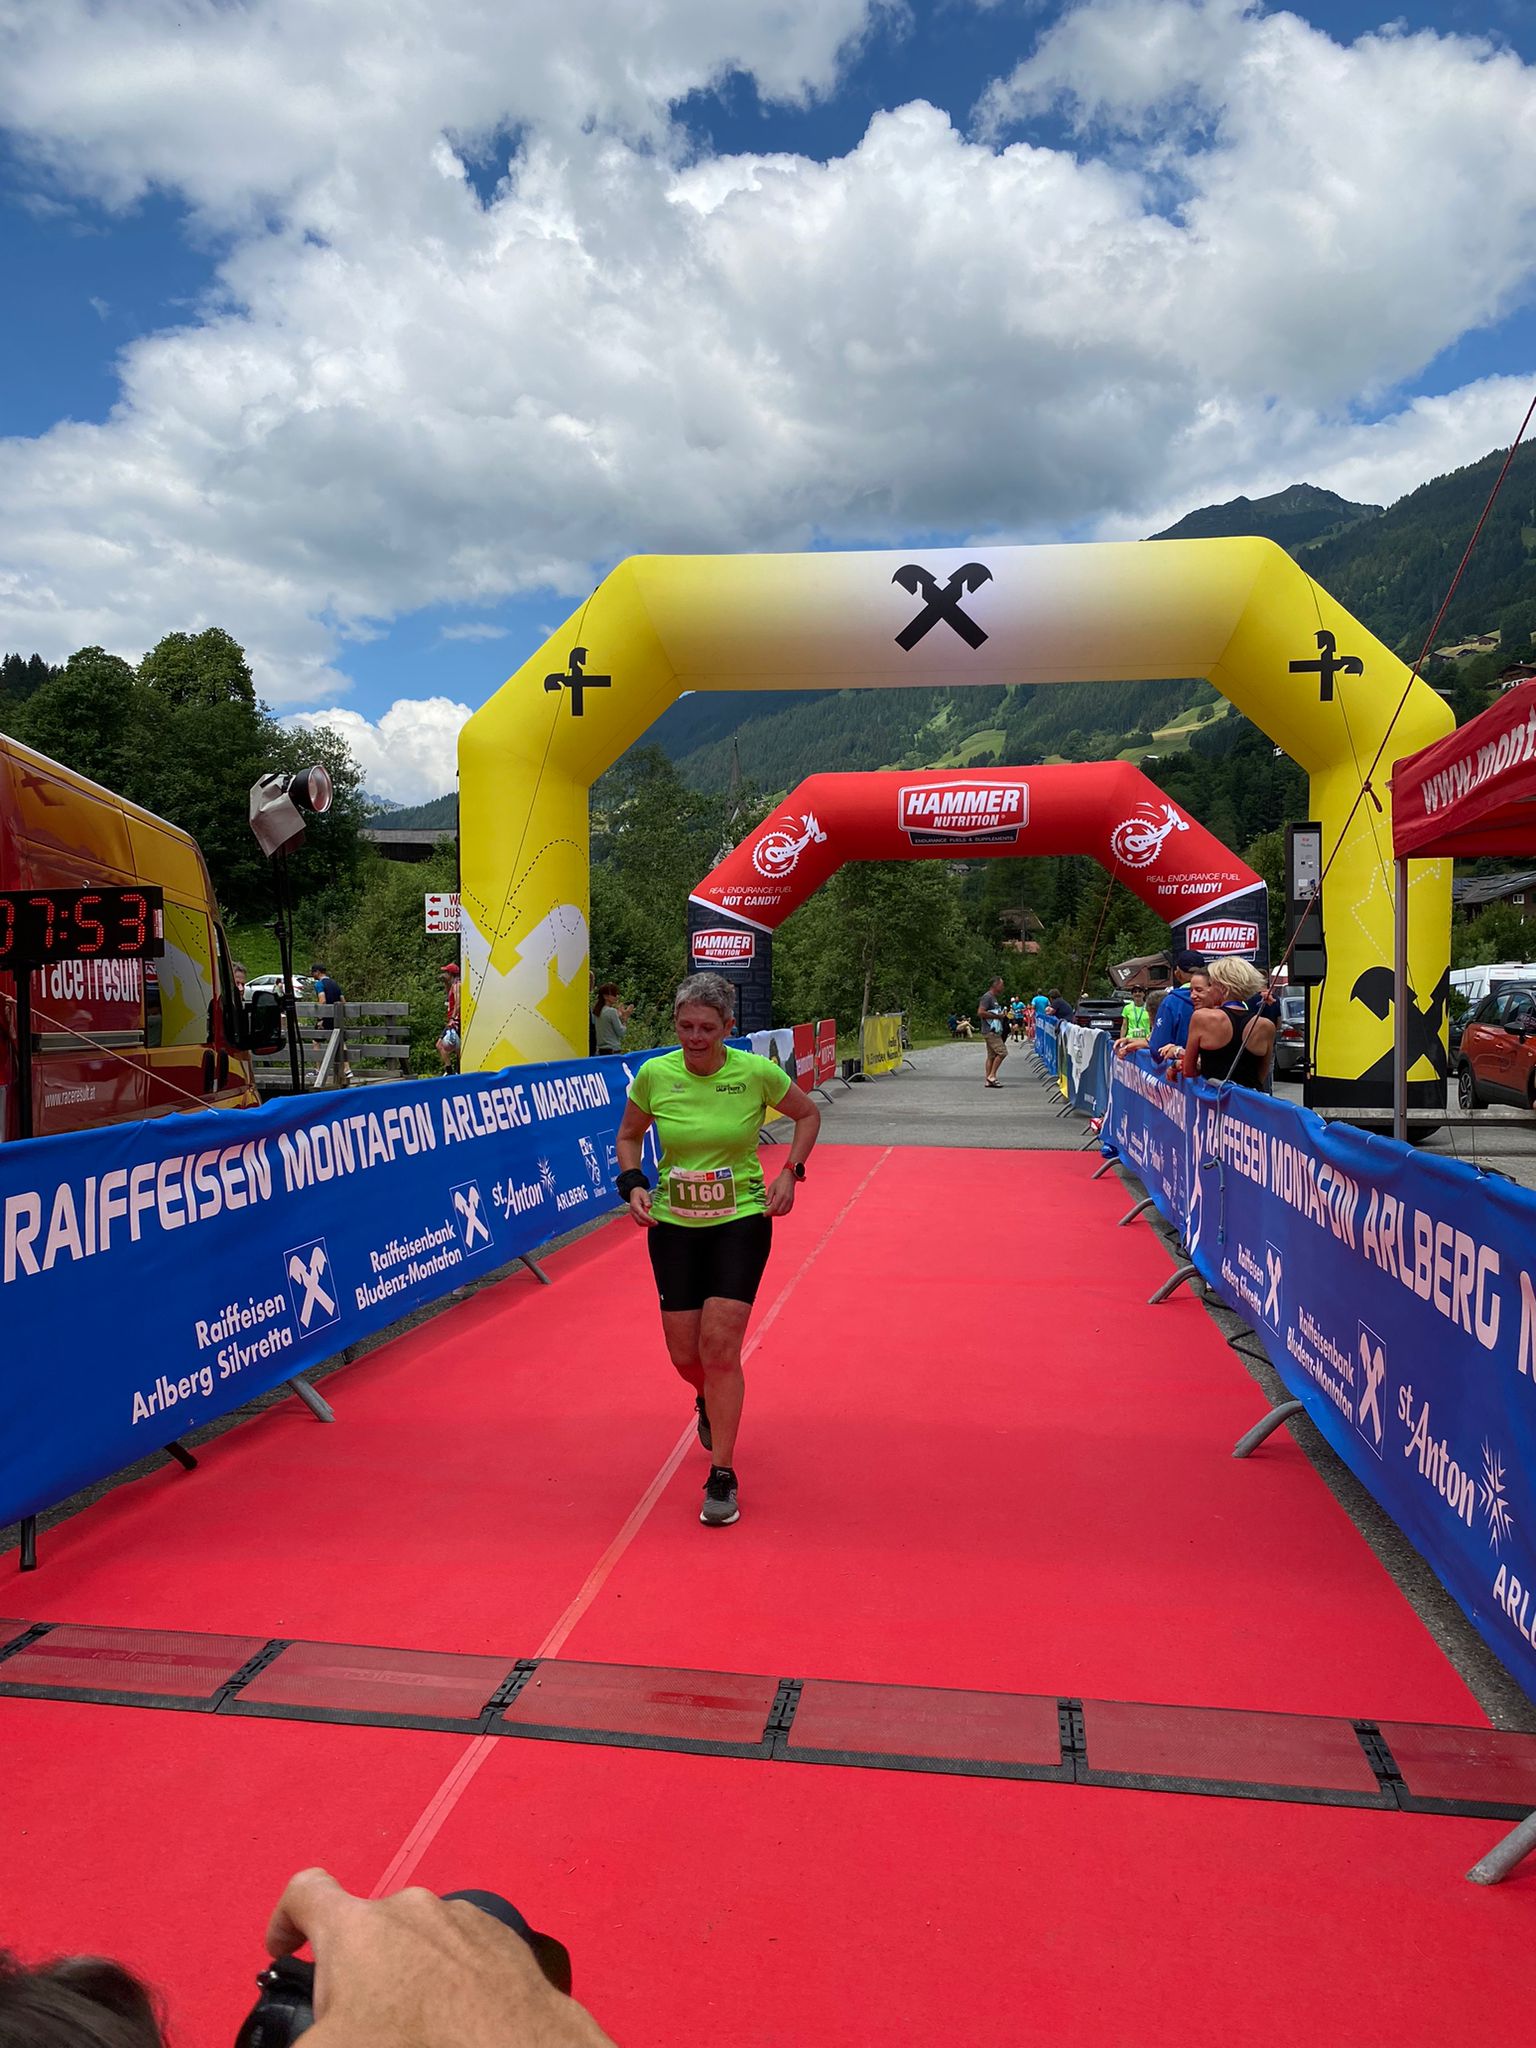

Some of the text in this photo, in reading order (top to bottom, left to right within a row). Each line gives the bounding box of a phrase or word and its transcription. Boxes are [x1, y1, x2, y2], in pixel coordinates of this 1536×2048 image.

[1421, 703, 1536, 815] www.mont
[906, 789, 1020, 816] HAMMER
[933, 814, 999, 828] NUTRITION
[726, 886, 773, 894] ENDURANCE
[1158, 882, 1222, 895] NOT CANDY!
[1167, 873, 1220, 882] ENDURANCE
[1220, 872, 1241, 881] FUEL
[722, 895, 781, 906] NOT CANDY!
[694, 935, 751, 950] HAMMER
[1190, 927, 1256, 944] HAMMER
[1205, 941, 1246, 949] NUTRITION
[3, 1072, 611, 1284] RAIFFEISEN MONTAFON ARLBERG MARATHON
[676, 1182, 725, 1202] 1160
[556, 1184, 589, 1212] ARLBERG
[1205, 1108, 1267, 1188] RAIFFEISEN
[1271, 1136, 1359, 1250] MONTAFON
[1363, 1187, 1500, 1350] ARLBERG
[370, 1219, 457, 1273] Raiffeisenbank
[355, 1247, 462, 1311] Bludenz-Montafon
[1238, 1243, 1264, 1287] Raiffeisen
[195, 1293, 287, 1350] Raiffeisen
[1299, 1306, 1354, 1387] Raiffeisenbank
[132, 1325, 293, 1425] Arlberg Silvretta
[1287, 1326, 1353, 1423] Bludenz-Montafon
